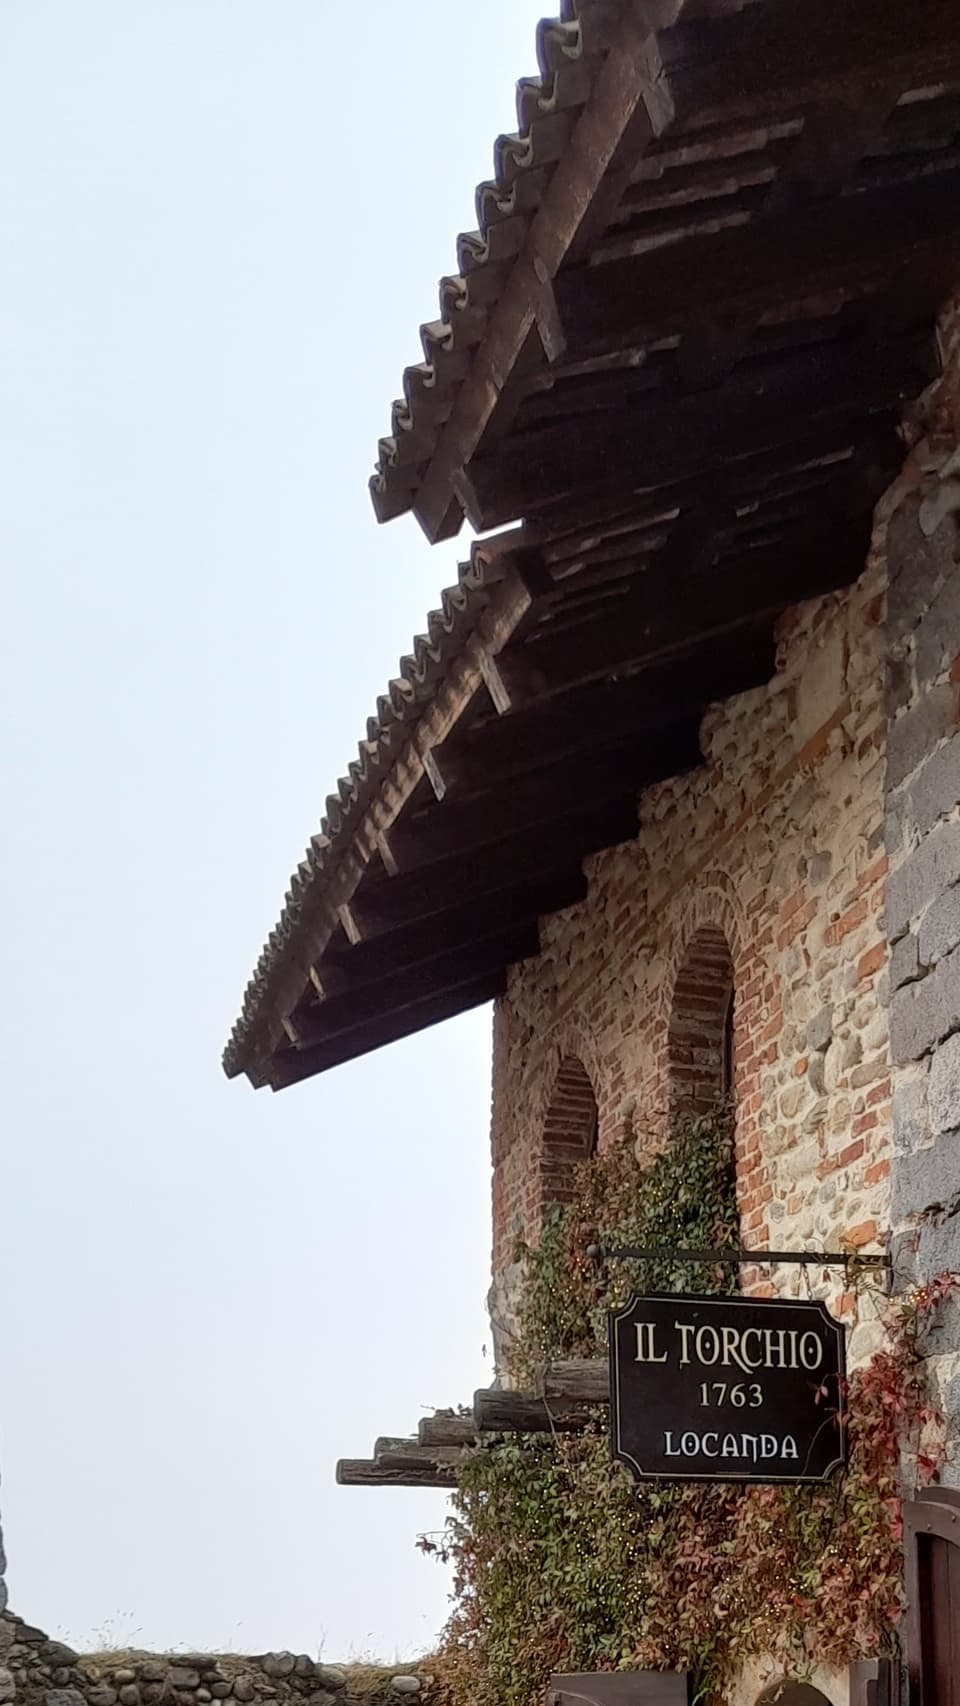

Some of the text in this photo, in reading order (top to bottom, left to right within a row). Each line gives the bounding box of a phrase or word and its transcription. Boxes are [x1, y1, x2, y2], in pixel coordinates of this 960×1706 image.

[634, 1319, 824, 1374] IL TORCHIO
[700, 1383, 763, 1407] 1763
[664, 1431, 799, 1463] LOCANDA
